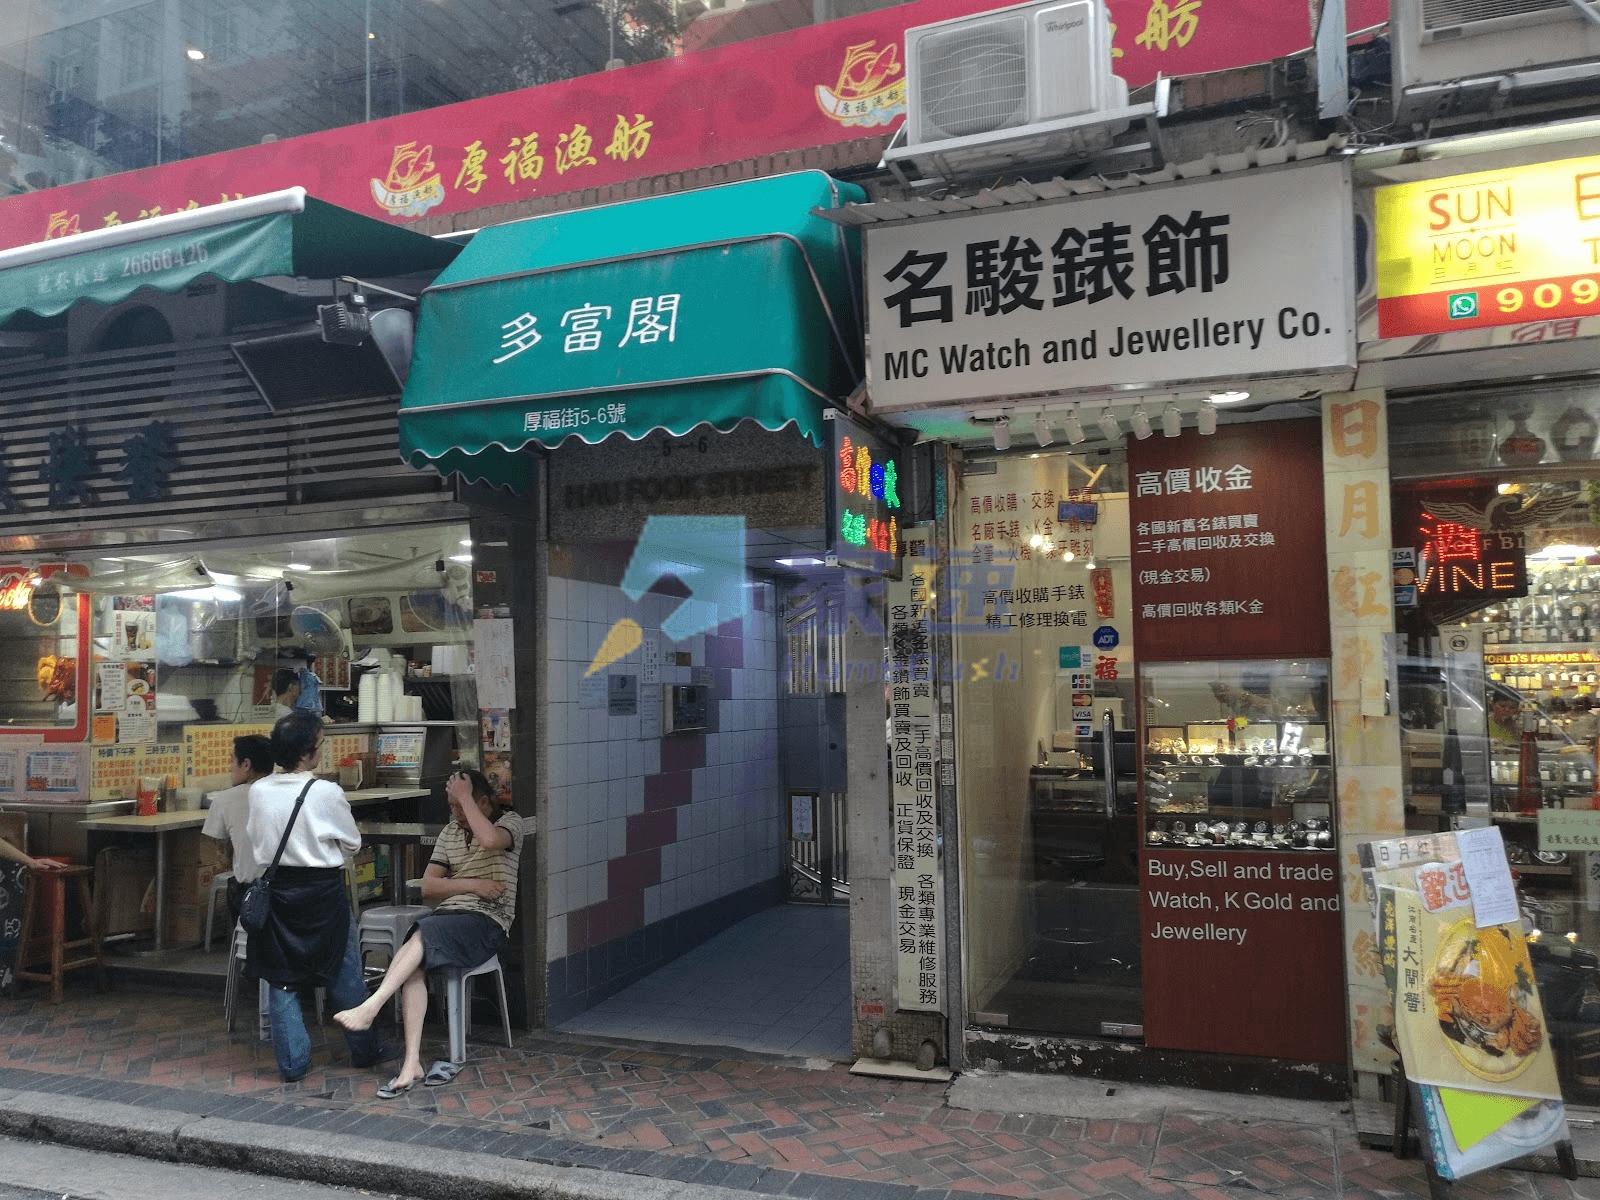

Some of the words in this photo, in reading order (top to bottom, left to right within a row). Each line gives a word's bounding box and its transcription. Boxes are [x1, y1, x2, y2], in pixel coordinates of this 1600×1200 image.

[454, 114, 653, 193] 厚福漁舫
[1429, 187, 1512, 231] SUN
[1433, 233, 1516, 263] MOON
[883, 210, 1230, 329] 名駿錶飾
[1496, 279, 1599, 313] 909
[492, 293, 681, 364] 多富閣
[884, 348, 928, 381] MC
[940, 338, 1030, 375] Watch
[1043, 329, 1097, 364] and
[1109, 316, 1264, 358] Jewellery
[1278, 306, 1331, 339] Co.
[1136, 464, 1252, 497] 高價收金
[1136, 513, 1259, 536] 各國新舊名錶買賣
[1137, 532, 1275, 554] 二手高價回收及交換
[1139, 567, 1211, 586] (現金交易)
[983, 584, 1086, 606] 高價收購手錶
[985, 610, 1088, 629] 精工修理換電
[1098, 634, 1115, 644] ADT
[1095, 655, 1118, 681] 福
[1530, 652, 1580, 664] FAMOUS
[1075, 710, 1091, 718] VISA
[914, 715, 935, 859] 二手高價回收及交換
[896, 803, 915, 870] 正貨保證
[1233, 862, 1272, 879] and
[1278, 863, 1334, 881] trade
[1149, 891, 1219, 911] Watch,
[1225, 891, 1240, 909] K
[1243, 892, 1293, 910] Gold
[1300, 894, 1340, 911] and
[898, 886, 916, 954] 現金交易
[1151, 921, 1248, 945] Jewellery
[917, 873, 937, 1005] 各類專業維修服務
[1402, 945, 1421, 1013] 大閘蟹
